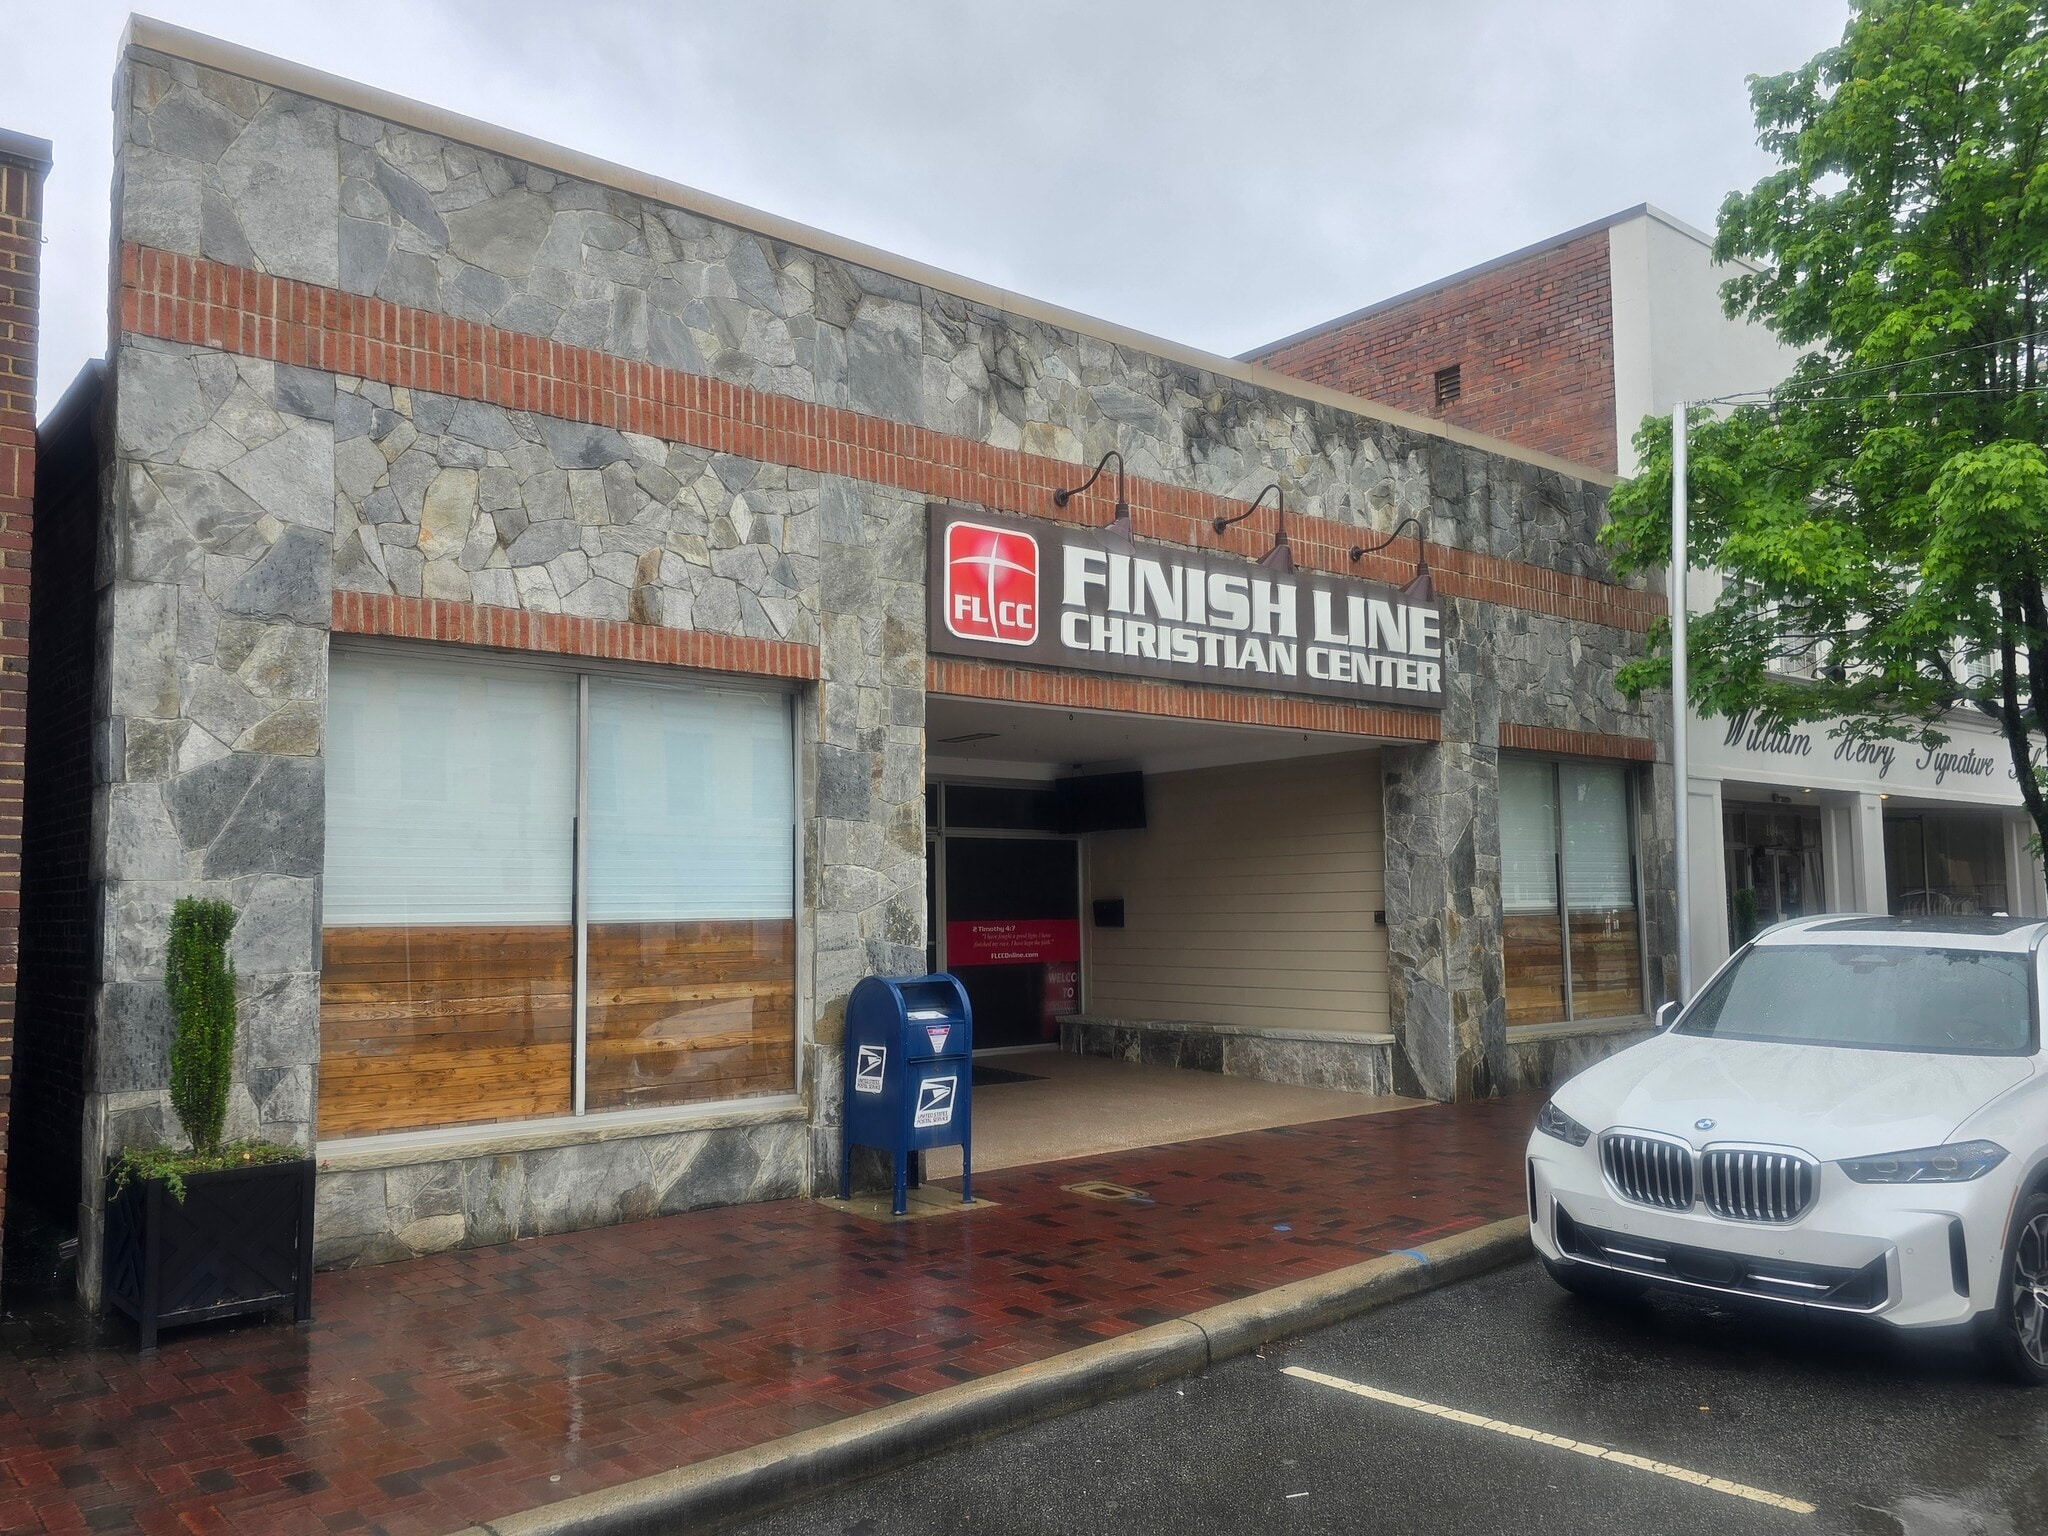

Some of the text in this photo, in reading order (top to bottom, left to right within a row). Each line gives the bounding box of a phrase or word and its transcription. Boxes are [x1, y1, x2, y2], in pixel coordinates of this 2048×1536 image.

[1062, 544, 1441, 658] FINISH LINE
[1060, 611, 1441, 693] CHRISTIAN CENTER
[1834, 719, 1896, 779] Henry
[1916, 742, 1994, 785] Signature
[1048, 971, 1078, 984] WELCO
[1062, 987, 1074, 998] TO
